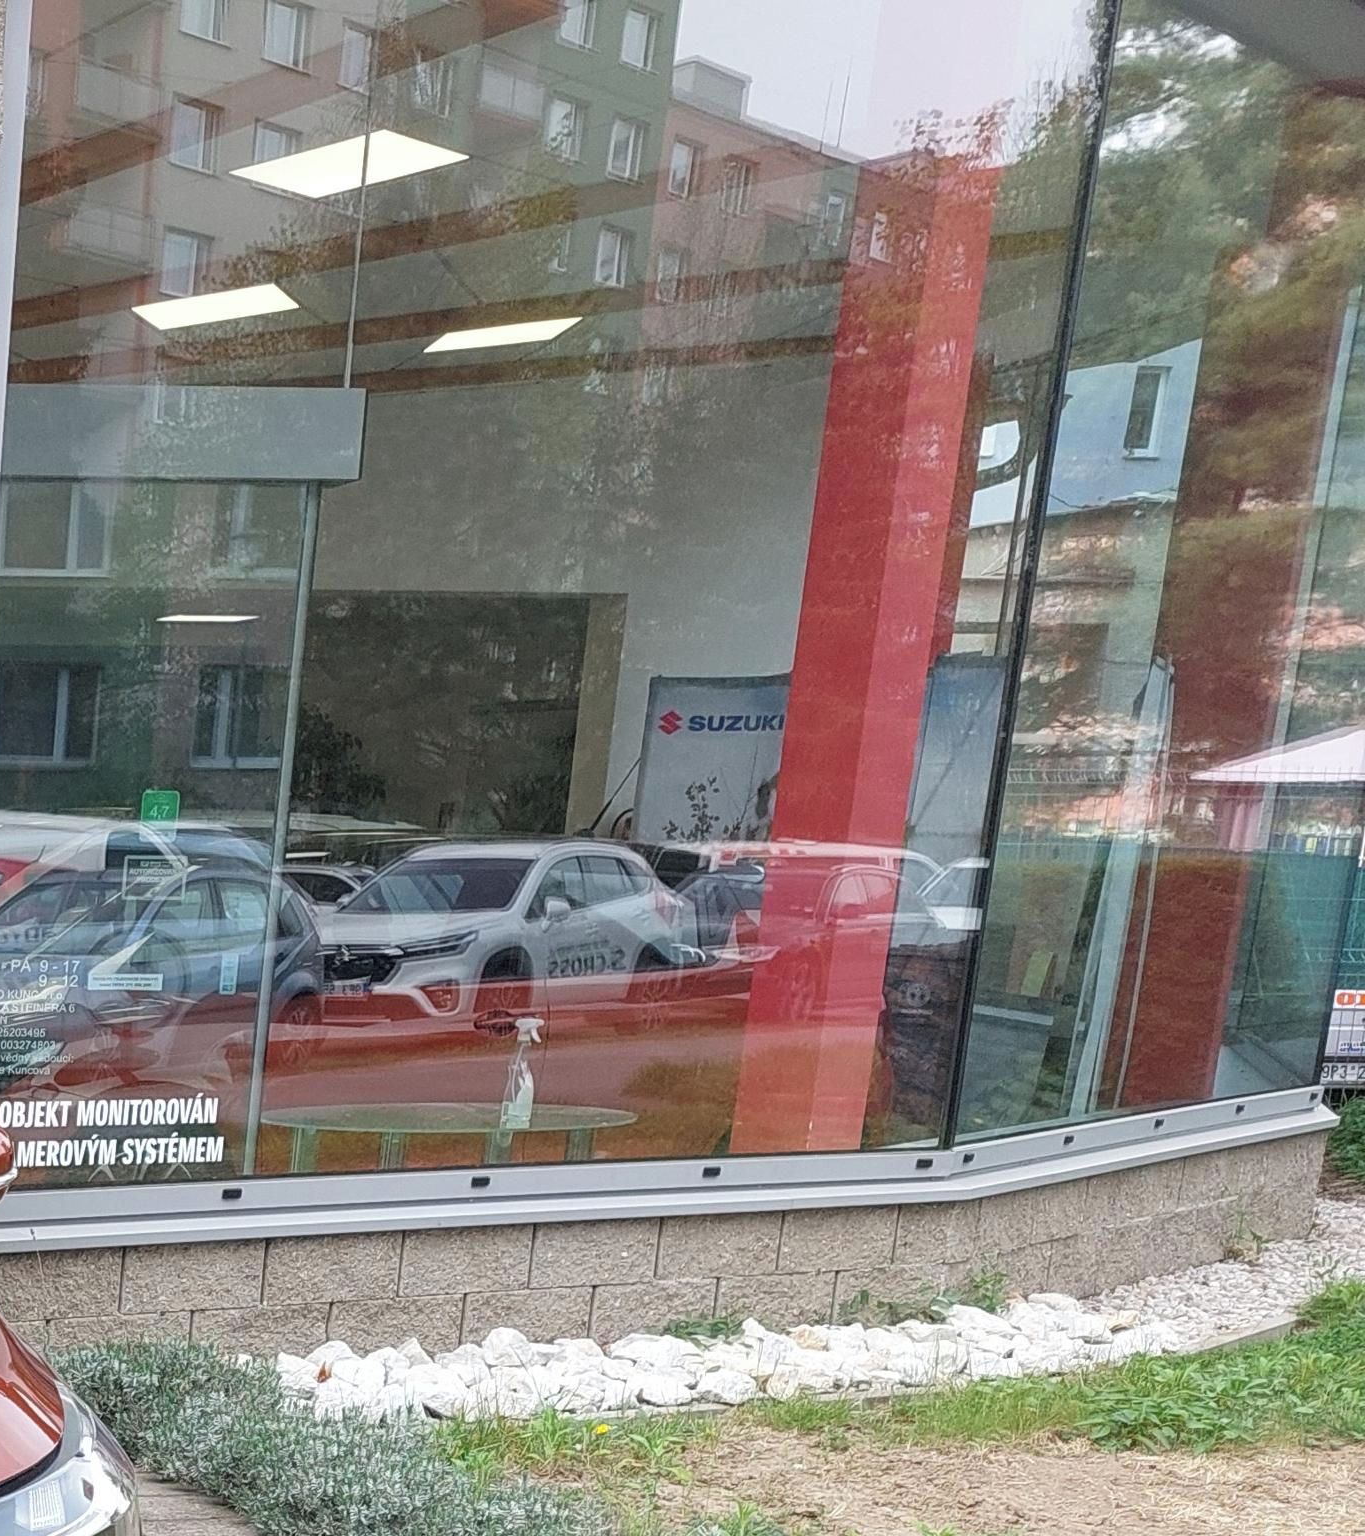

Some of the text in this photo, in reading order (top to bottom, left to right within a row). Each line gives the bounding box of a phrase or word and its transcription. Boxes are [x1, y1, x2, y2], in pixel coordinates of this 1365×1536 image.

[687, 715, 785, 732] SUZUKI
[39, 960, 49, 972] 9
[63, 960, 80, 973] 17
[38, 975, 47, 987] 9
[62, 975, 79, 987] 12
[69, 1003, 76, 1013] 6
[1321, 1065, 1348, 1080] 9P3
[76, 1092, 219, 1128] MONITOROVÁN
[14, 1132, 225, 1168] MEROVÝM SYSTÉMEM
